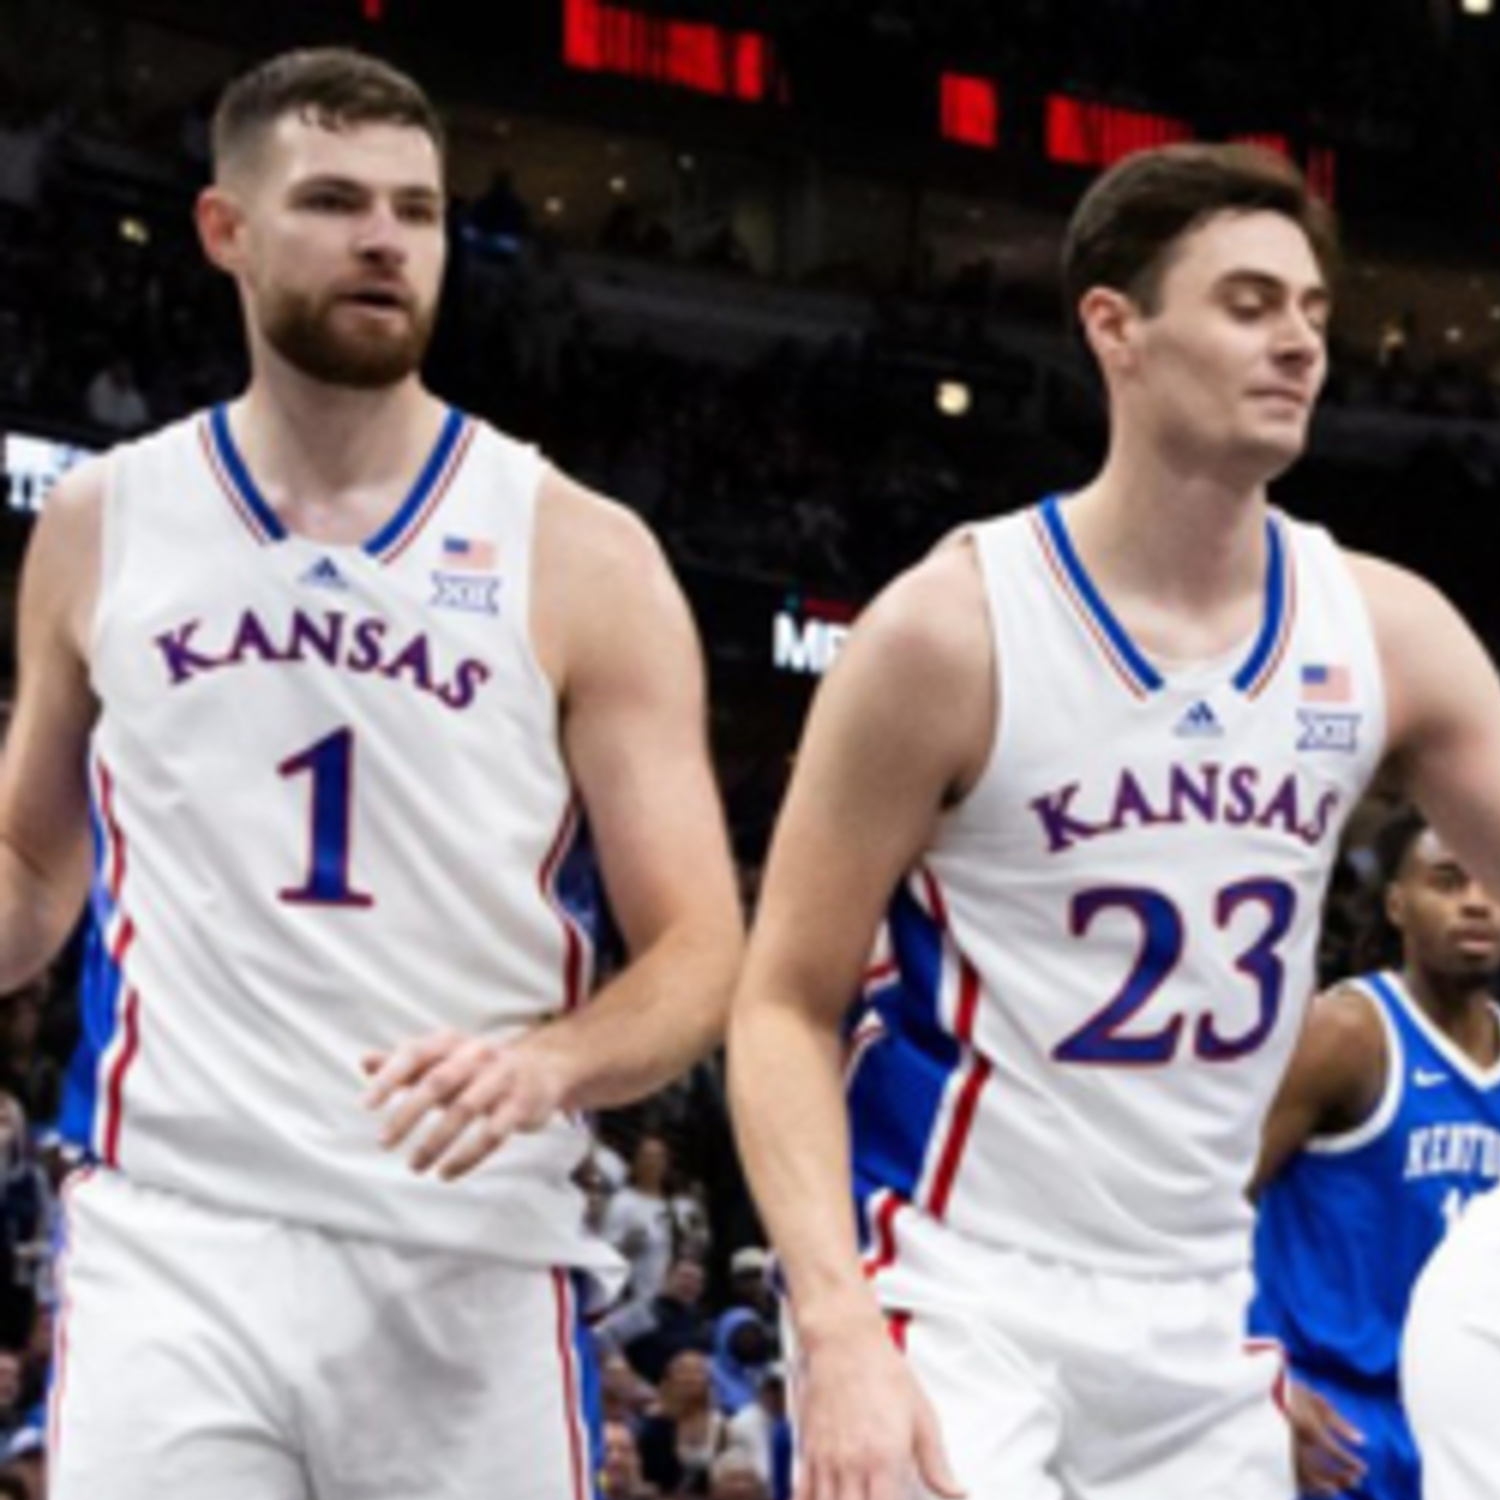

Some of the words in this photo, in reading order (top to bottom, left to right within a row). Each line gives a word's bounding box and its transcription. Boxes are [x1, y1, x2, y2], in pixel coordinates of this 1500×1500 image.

[155, 607, 492, 711] KANSAS
[276, 724, 375, 909] 1
[1029, 763, 1340, 854] KANSAS
[1051, 876, 1298, 1066] 23
